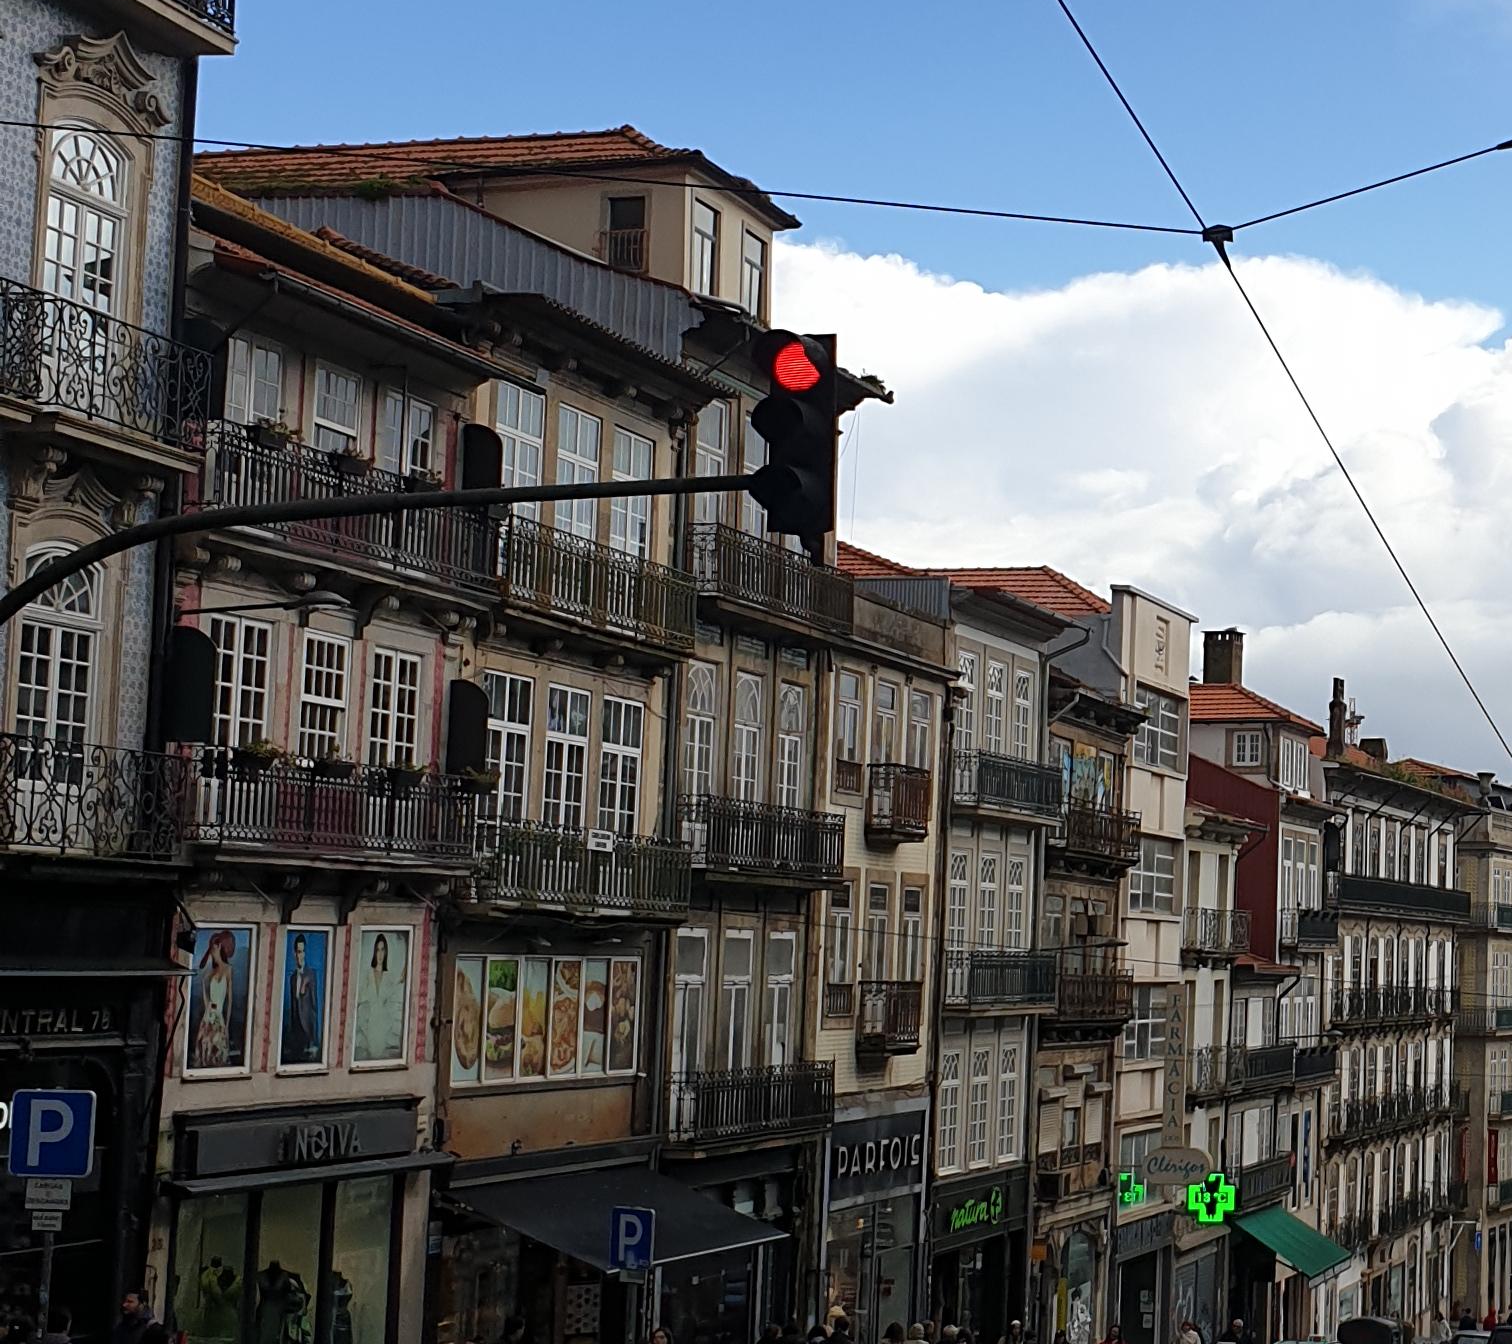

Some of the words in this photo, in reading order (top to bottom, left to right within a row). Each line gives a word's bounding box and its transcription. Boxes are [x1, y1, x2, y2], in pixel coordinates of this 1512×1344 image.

[26, 1099, 74, 1167] P
[837, 1133, 921, 1179] PARFOIS
[618, 1213, 644, 1262] P
[950, 1199, 990, 1233] natura
